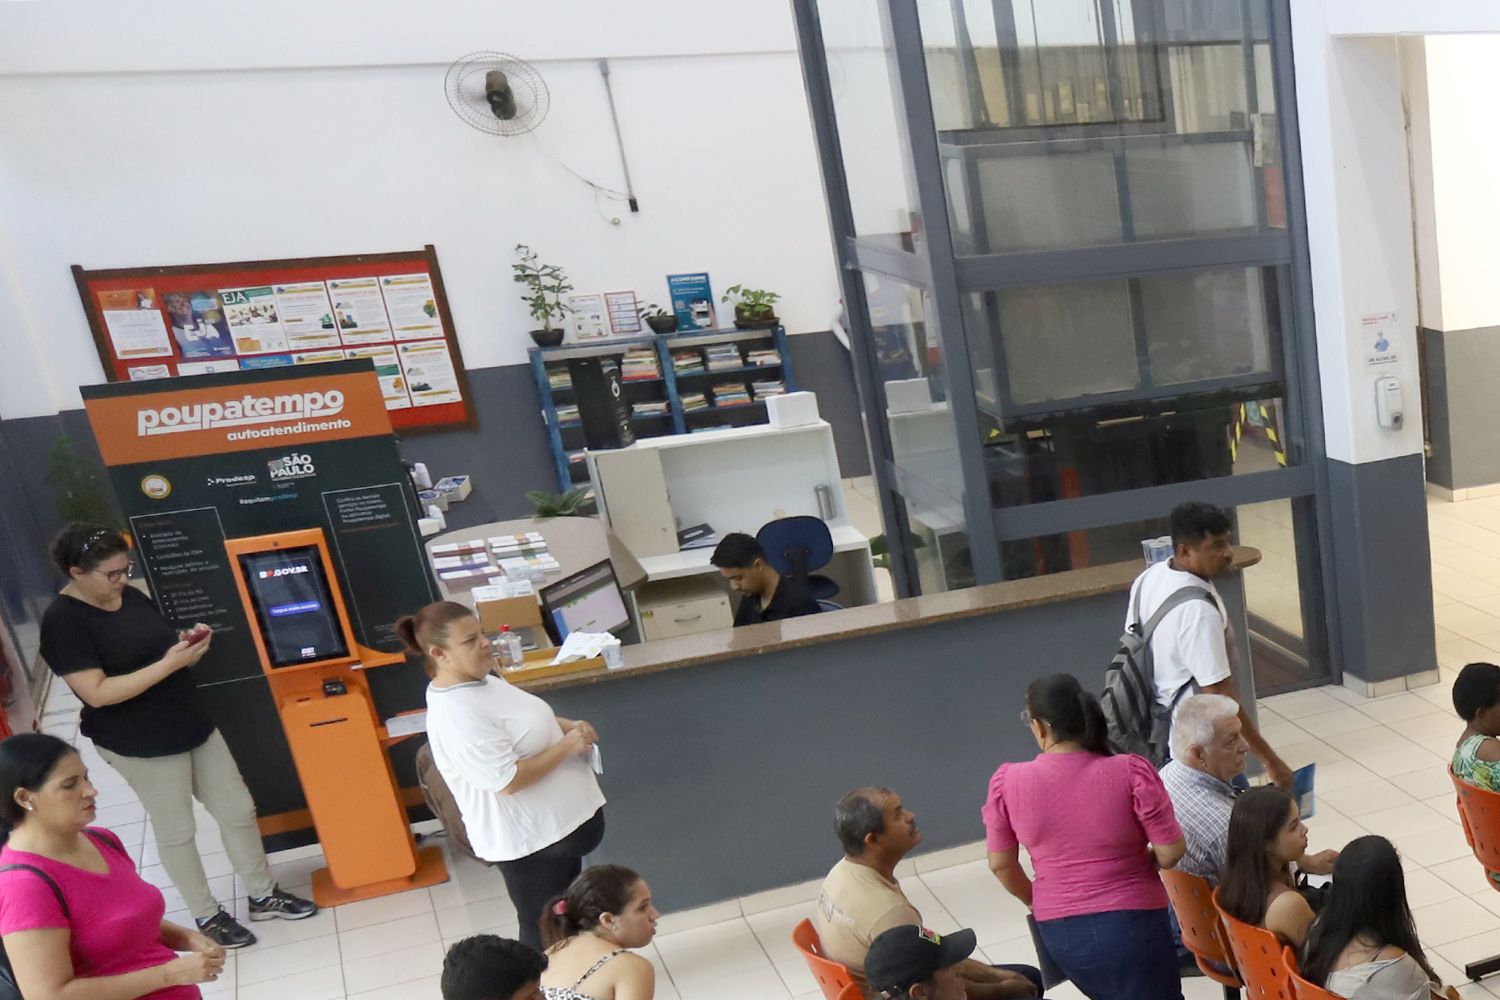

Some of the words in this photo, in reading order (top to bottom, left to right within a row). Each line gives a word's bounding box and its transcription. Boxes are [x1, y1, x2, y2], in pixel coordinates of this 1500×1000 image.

[221, 292, 248, 305] EJA
[137, 389, 344, 437] poupatempo
[227, 418, 351, 442] autoatendimento
[283, 453, 312, 467] SÃO
[270, 464, 315, 478] PAULO
[215, 475, 256, 484] Prodesp
